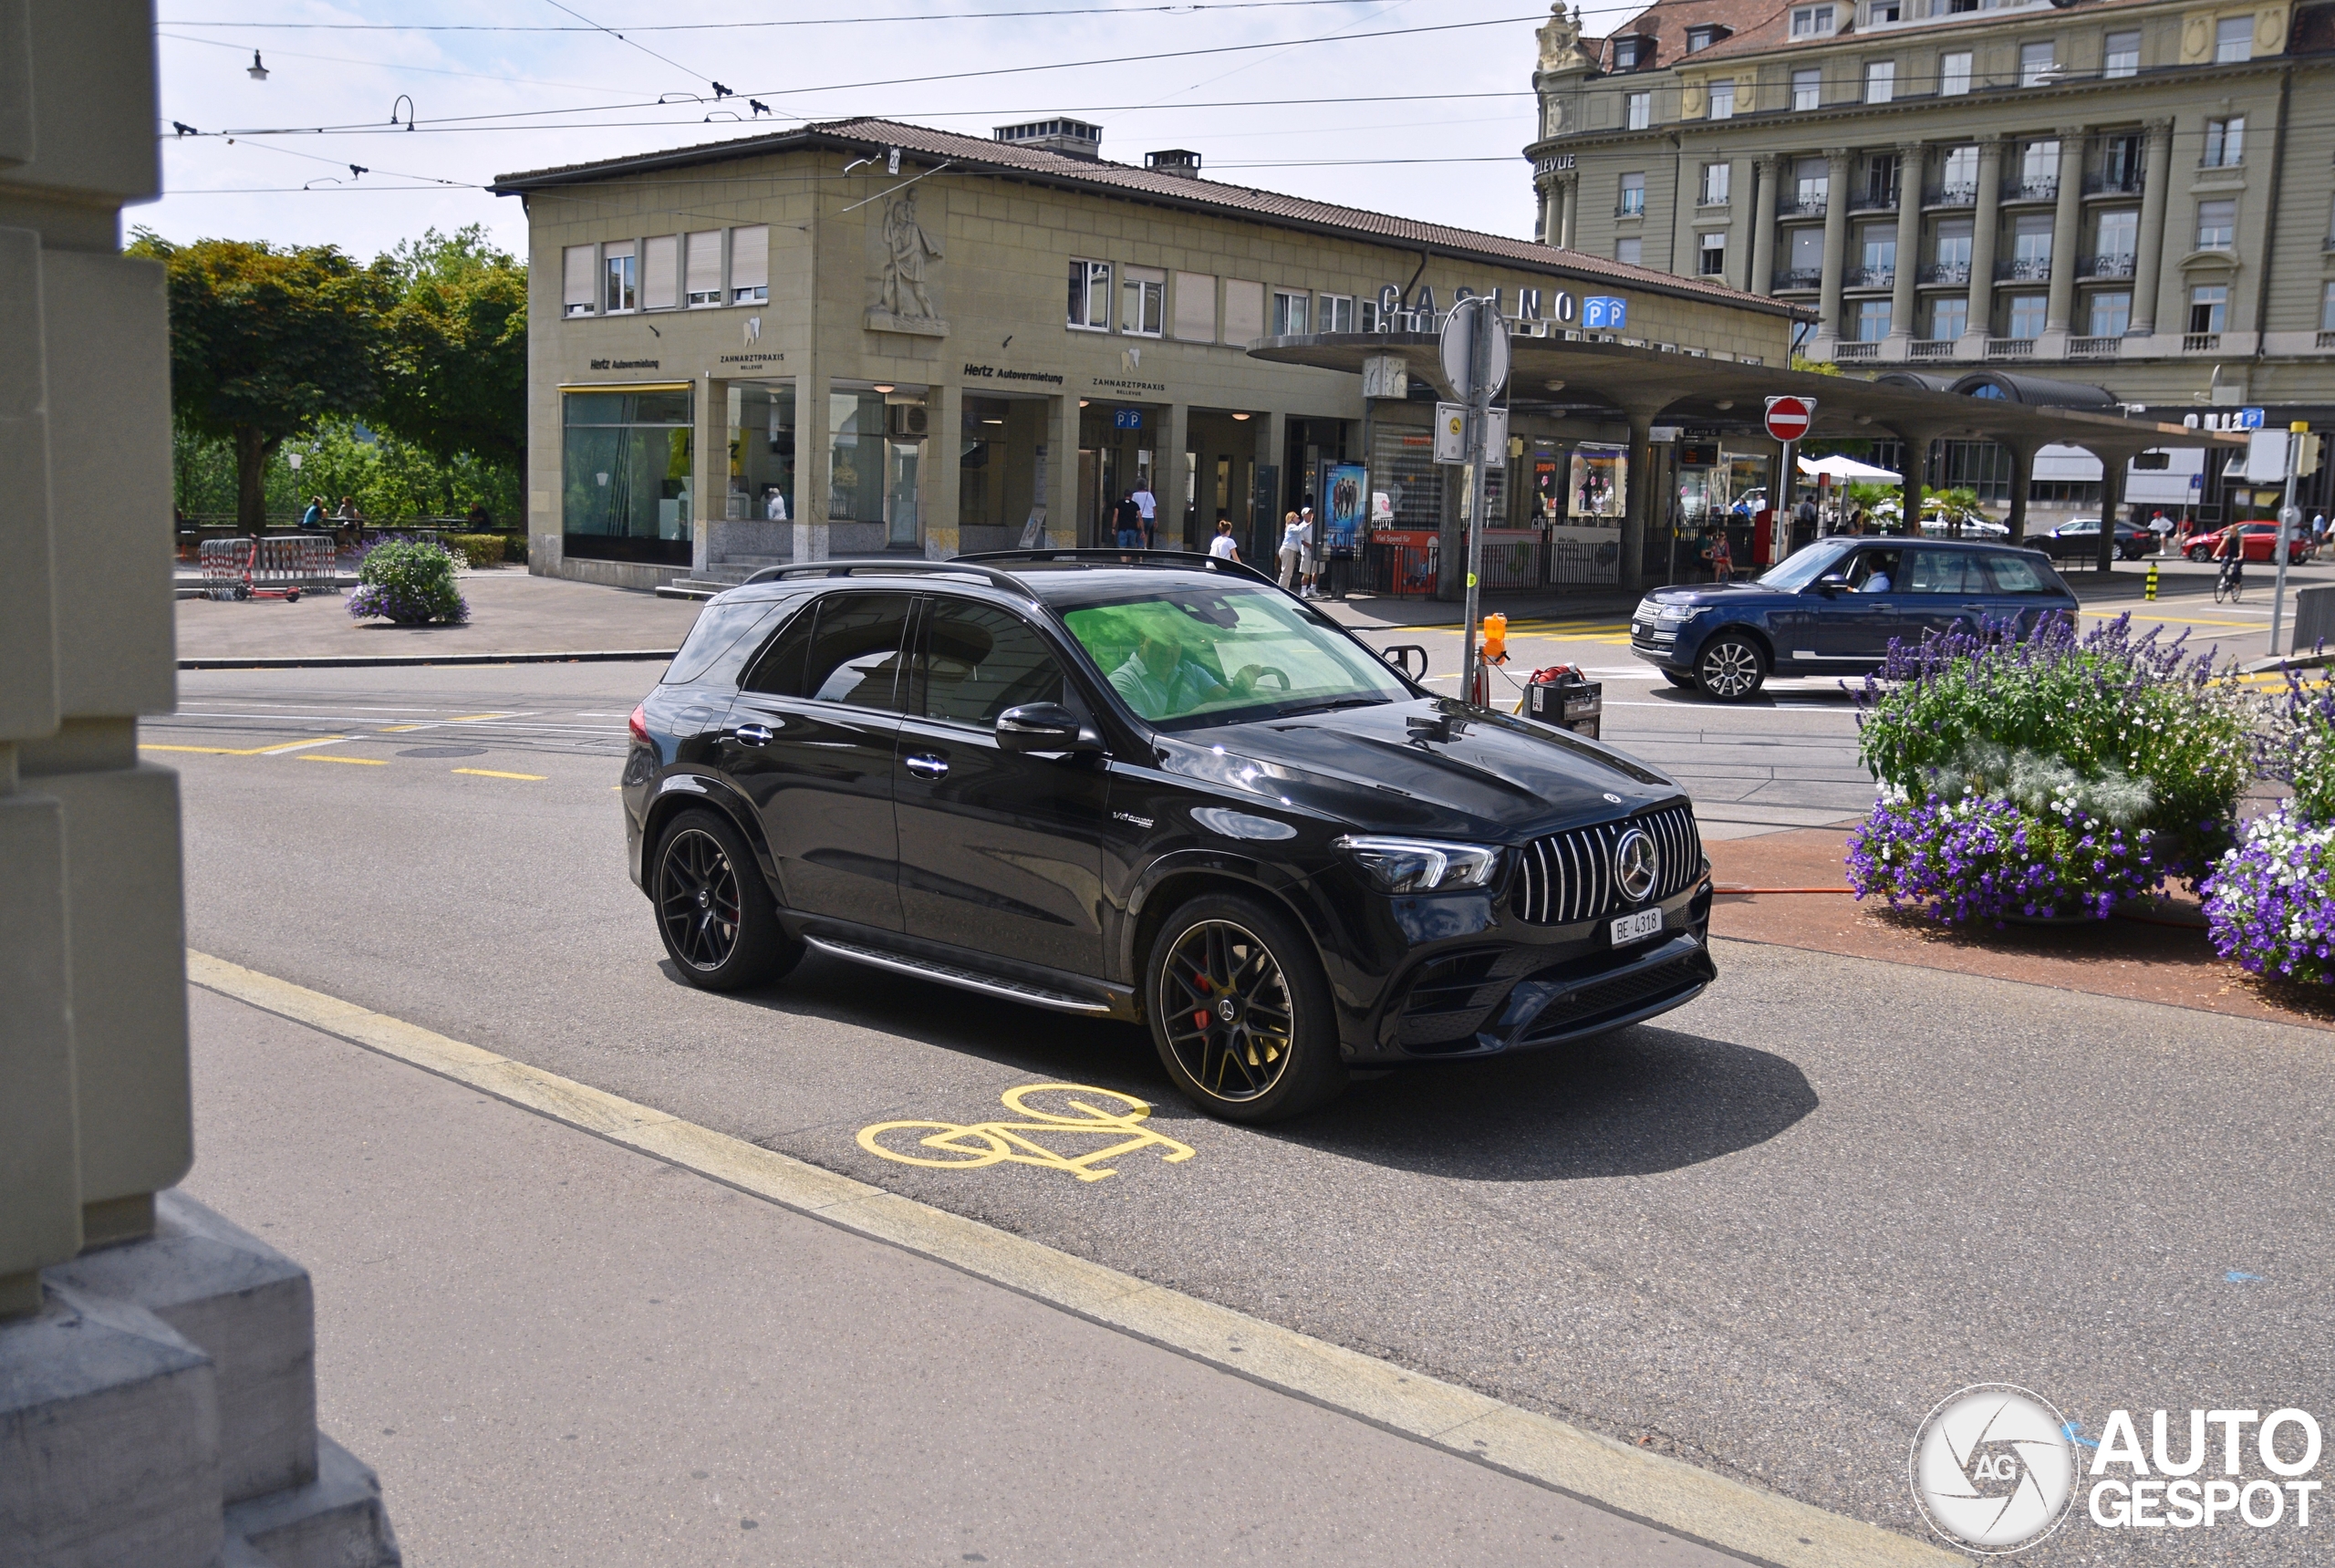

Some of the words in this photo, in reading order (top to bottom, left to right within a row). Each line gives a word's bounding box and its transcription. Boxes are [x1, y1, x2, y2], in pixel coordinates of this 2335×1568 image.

[1589, 306, 1602, 325] P
[1610, 306, 1621, 324] P
[590, 358, 609, 370] Hertz
[612, 358, 659, 370] Autovermietung
[721, 353, 784, 363] ZAHNARZTPRAXIS
[963, 363, 994, 378] Hertz
[997, 368, 1064, 385] Autovermietung
[1093, 378, 1166, 391] ZAHNARZTPRAXIS
[1116, 389, 1142, 397] BELLEVUE
[1117, 414, 1125, 426] P
[1131, 415, 1138, 427] P
[1327, 533, 1356, 547] KNIE
[1386, 535, 1403, 544] Speed
[1403, 535, 1411, 543] für
[1617, 920, 1628, 940] BE
[1635, 913, 1656, 934] 4318
